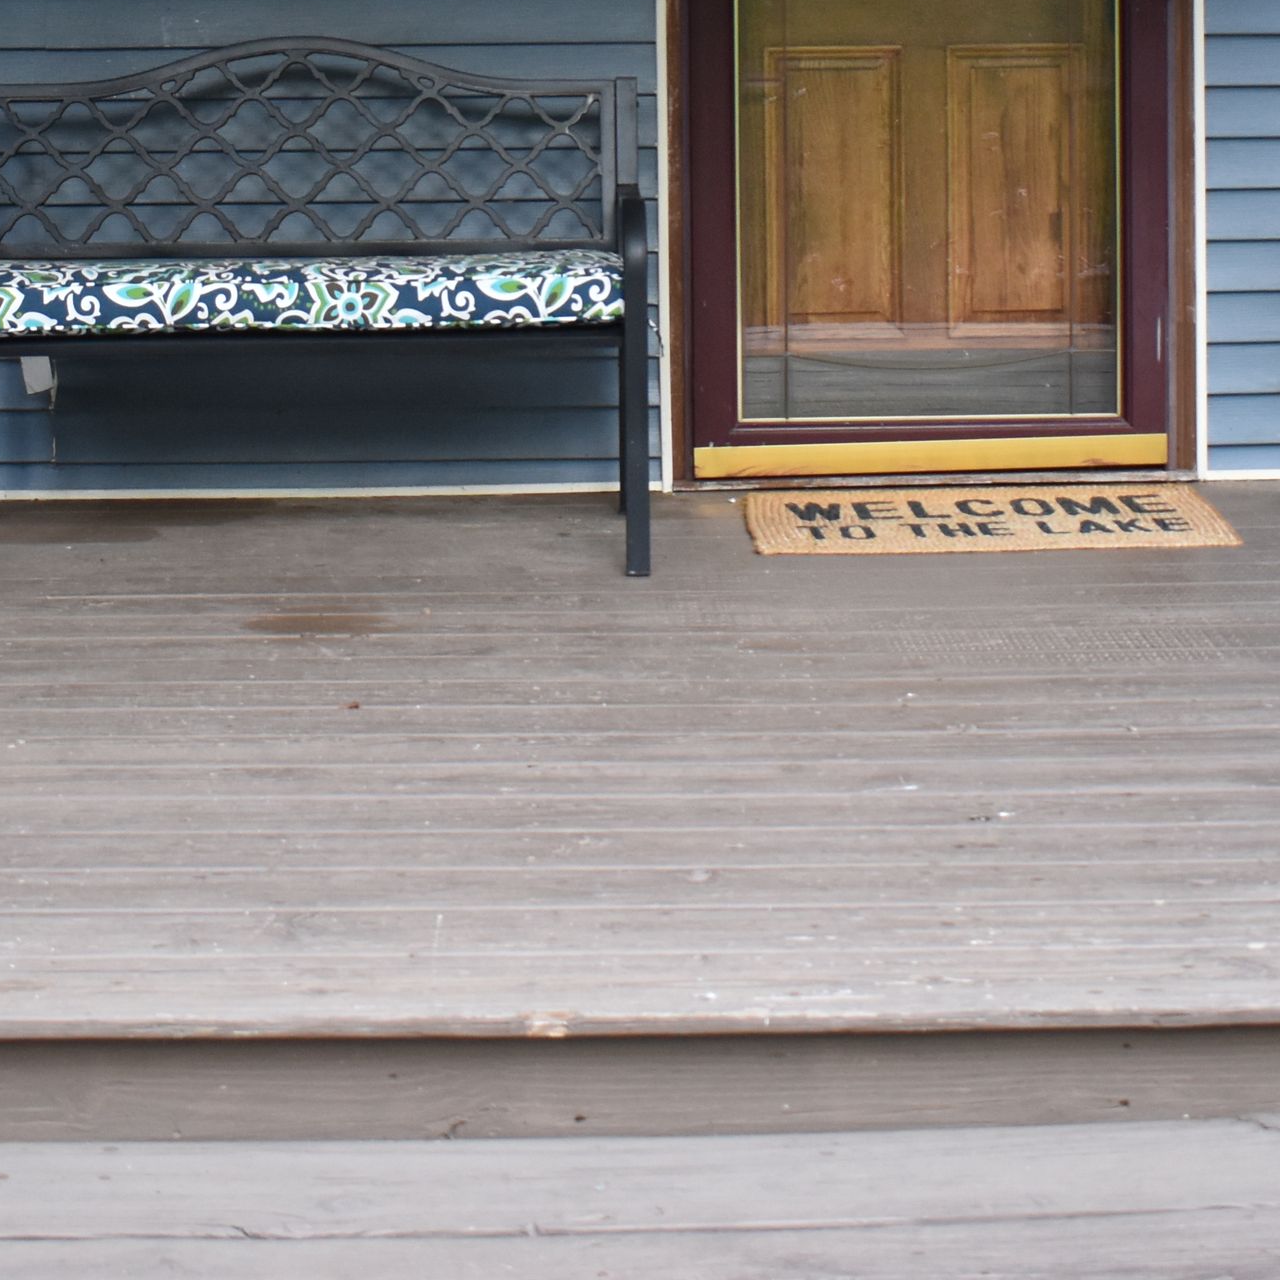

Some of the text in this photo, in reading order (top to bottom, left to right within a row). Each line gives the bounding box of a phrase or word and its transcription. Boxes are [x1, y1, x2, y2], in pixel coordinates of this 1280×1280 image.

[785, 493, 1177, 521] WELCOME
[795, 516, 1195, 541] TO THE LAKE
